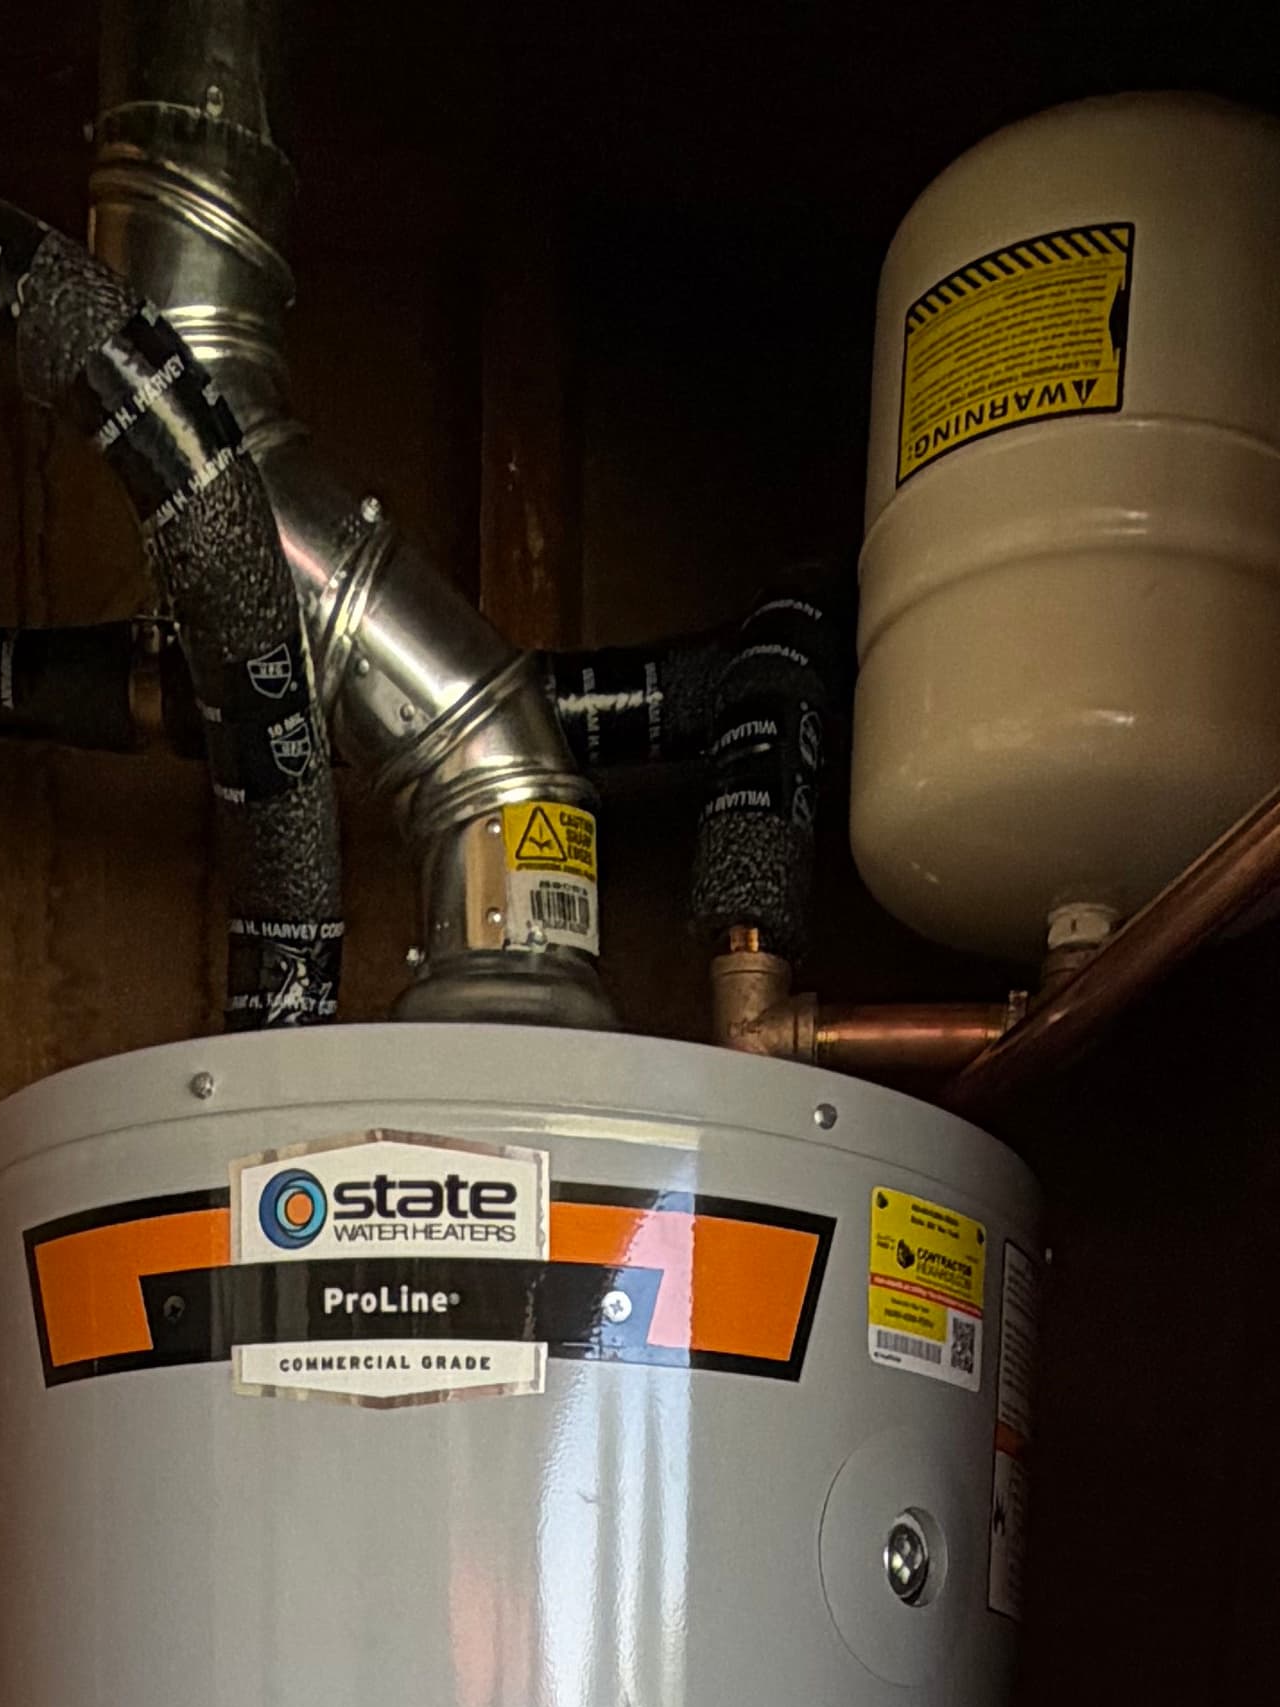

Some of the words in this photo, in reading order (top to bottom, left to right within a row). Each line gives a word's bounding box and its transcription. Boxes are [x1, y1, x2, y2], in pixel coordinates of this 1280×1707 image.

[133, 353, 185, 414] HARVEY
[905, 382, 1067, 463] WARNING:
[261, 921, 318, 940] HARVEY
[333, 1174, 517, 1221] state
[333, 1223, 408, 1242] WATER
[412, 1223, 516, 1243] HEATERS
[279, 1356, 411, 1373] COMMERCIAL
[421, 1355, 492, 1371] GRADE
